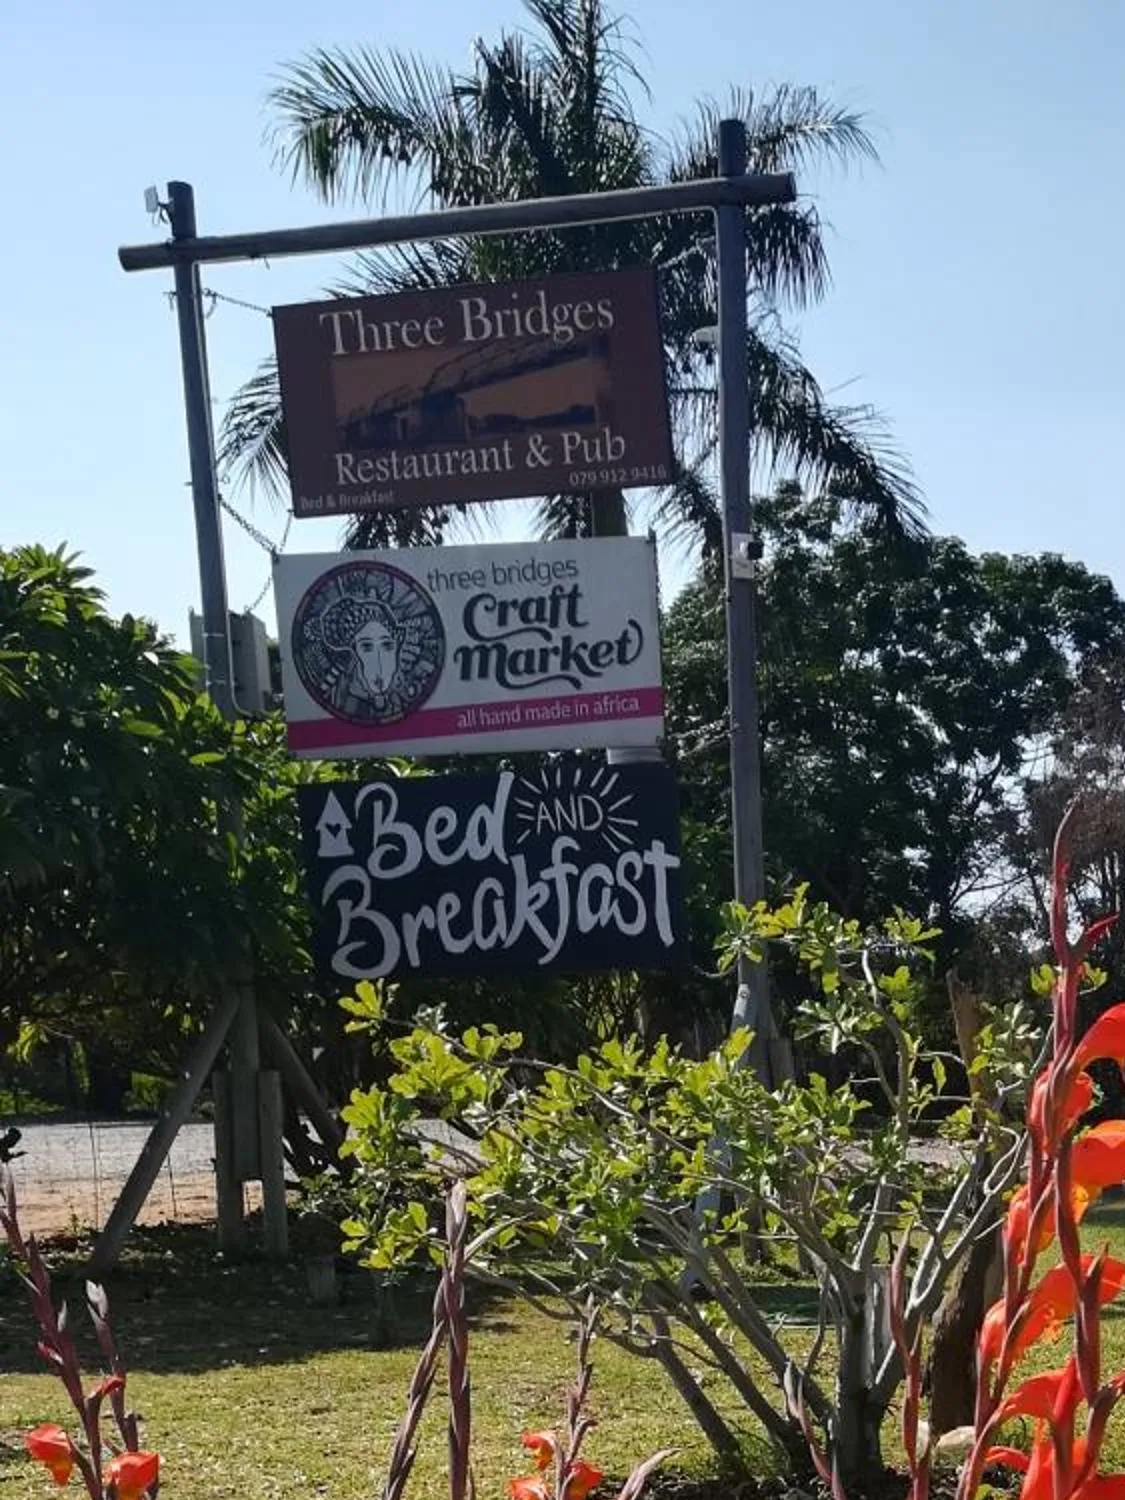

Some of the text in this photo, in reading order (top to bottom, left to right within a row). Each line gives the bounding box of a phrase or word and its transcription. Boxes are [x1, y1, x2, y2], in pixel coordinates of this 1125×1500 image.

[319, 289, 615, 357] Three Bridges
[335, 427, 626, 486] Restaurant & Pub
[427, 557, 579, 593] three bridges
[462, 583, 590, 643] Craft
[457, 695, 640, 729] all hand made in africa
[355, 771, 604, 880] Bed AND
[321, 835, 681, 979] Breakfast
